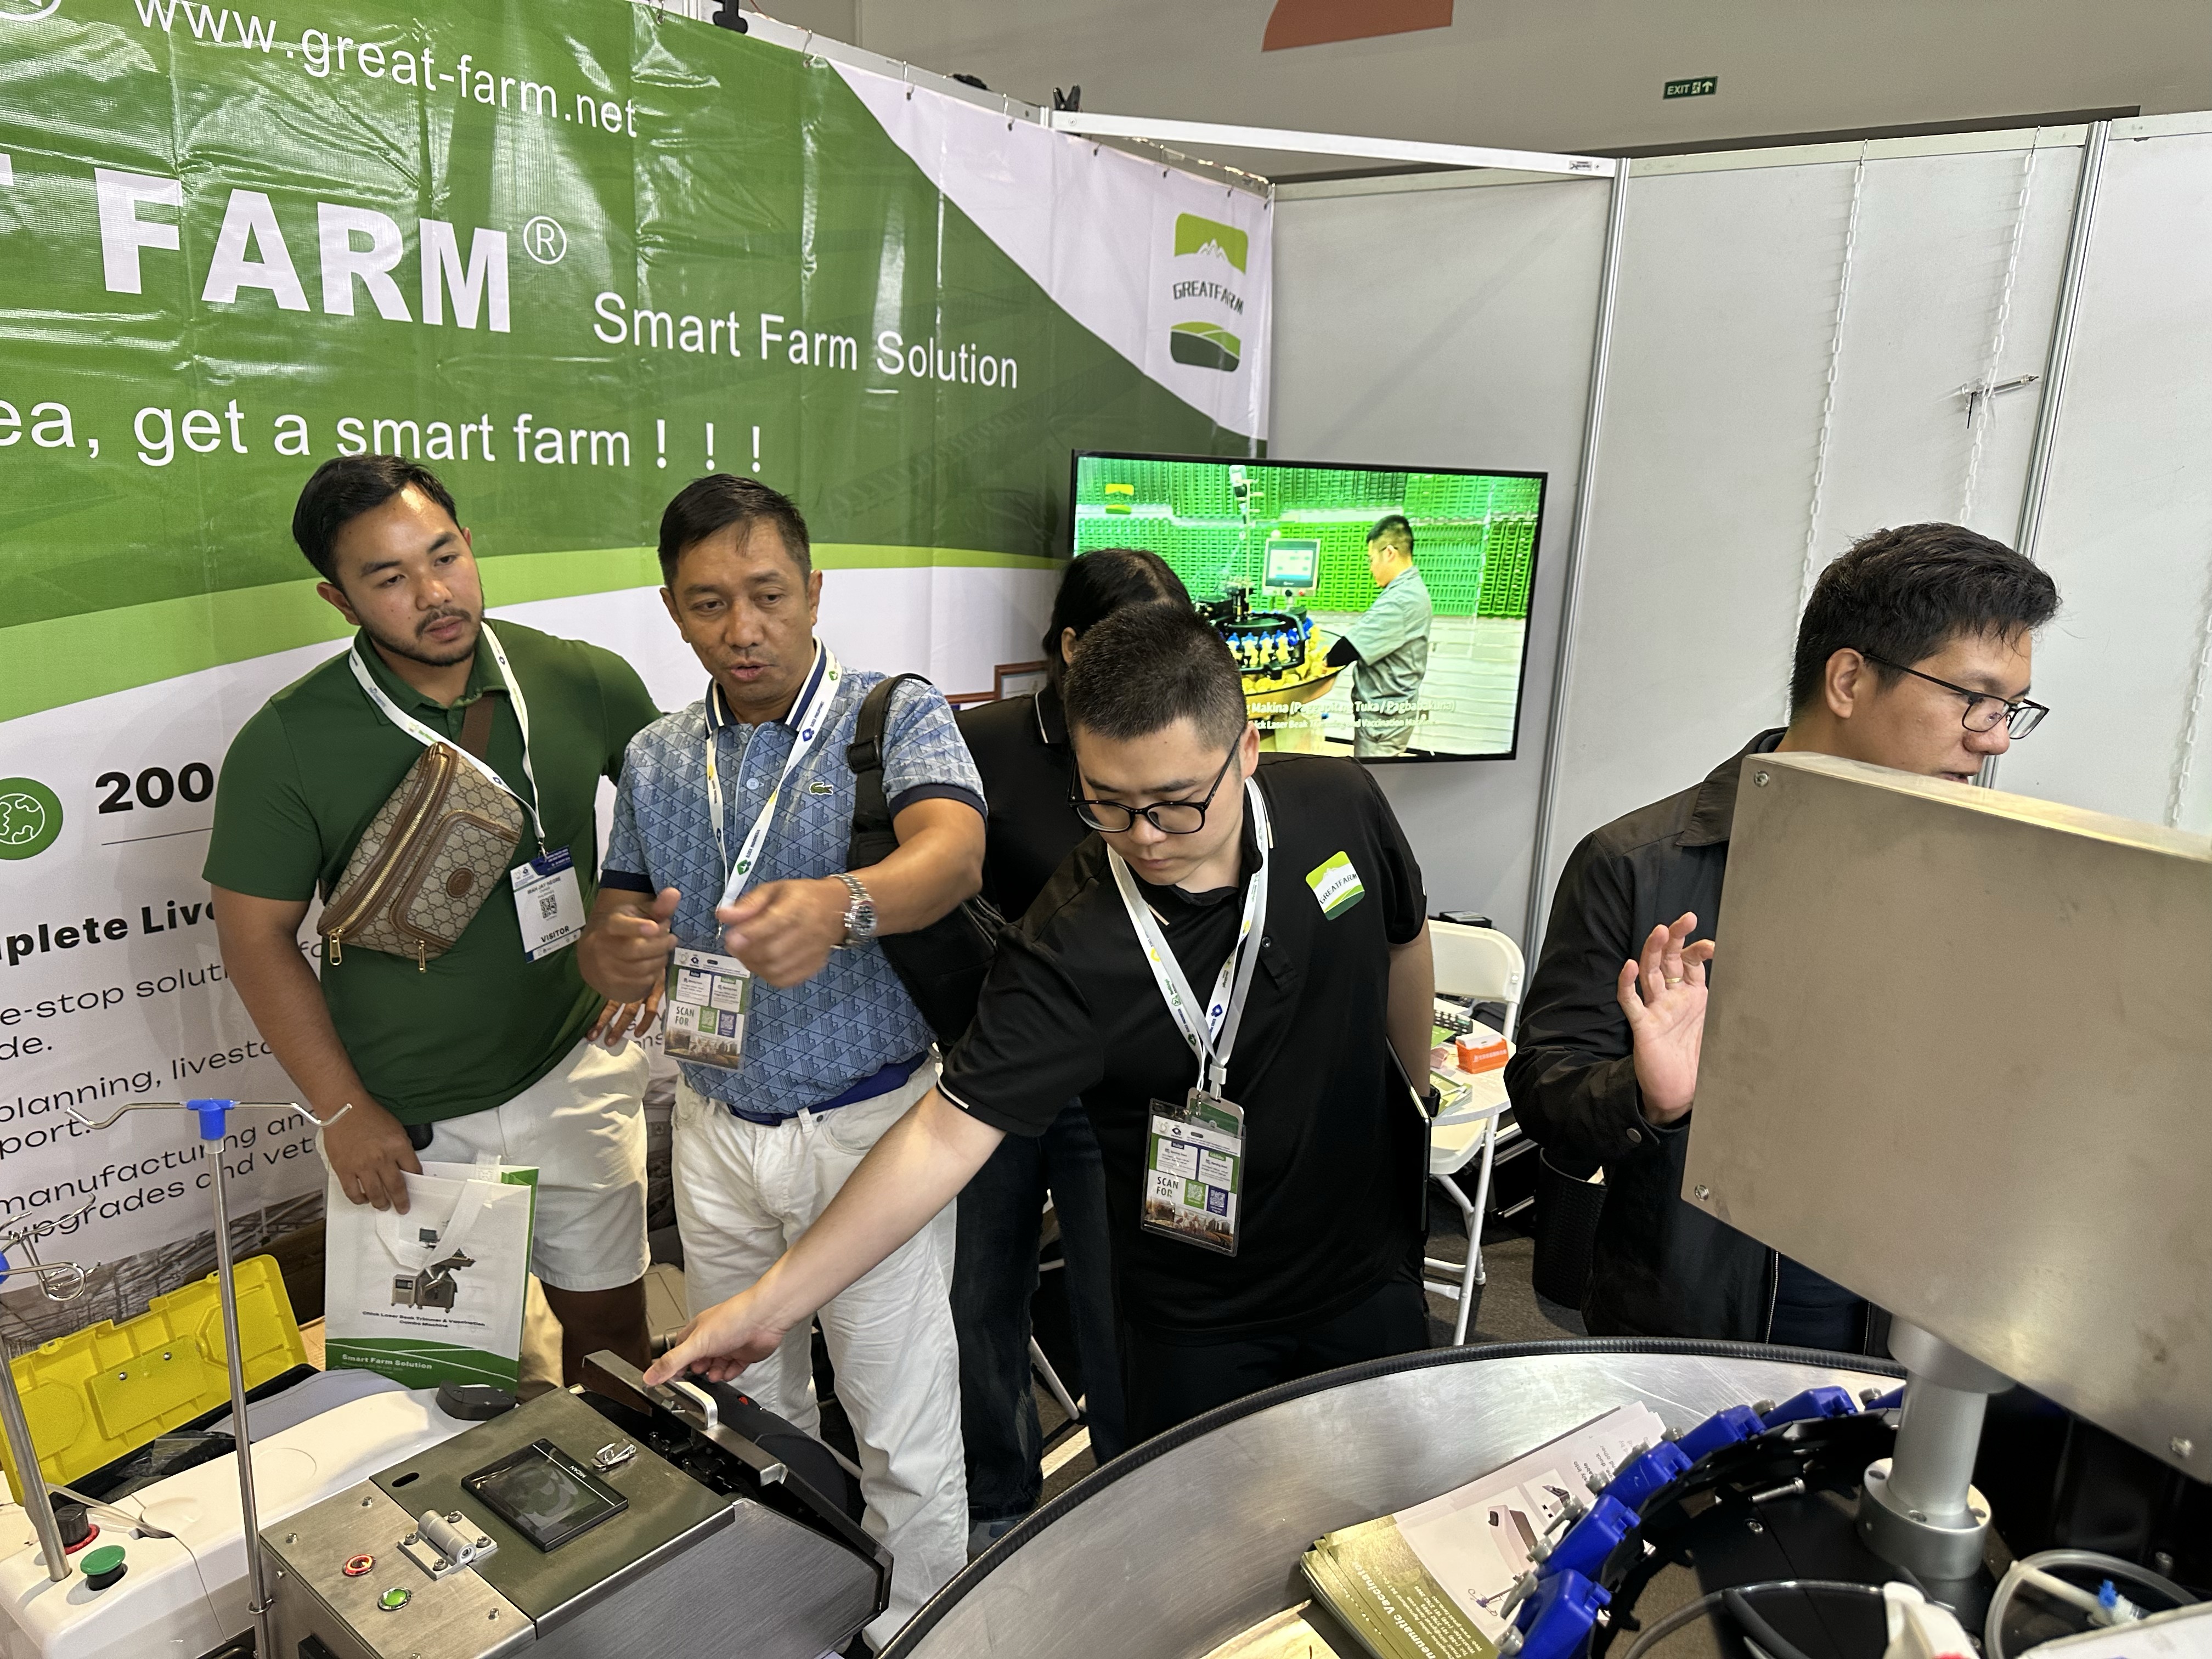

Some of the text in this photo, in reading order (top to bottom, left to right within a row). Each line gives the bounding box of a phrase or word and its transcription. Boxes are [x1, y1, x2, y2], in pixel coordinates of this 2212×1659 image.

[135, 0, 637, 138] www.great-farm.net
[1667, 83, 1690, 95] EXIT
[94, 167, 511, 333] FARM
[1173, 280, 1244, 315] GREATFARM
[594, 291, 1018, 389] Smart Farm Solution
[133, 398, 249, 467] get
[274, 414, 311, 456] a
[336, 413, 495, 461] smart
[513, 413, 630, 467] farm
[1251, 701, 1289, 713] Makina
[1355, 701, 1380, 712] Tuka
[1362, 719, 1404, 727] Vaccination
[95, 762, 214, 814] 200
[1319, 873, 1358, 904] GREATFARM
[0, 917, 129, 967] plete
[540, 925, 570, 943] VISITOR
[0, 987, 124, 1025] e-stop
[675, 1016, 689, 1026] FOR
[676, 1006, 695, 1017] SCAN
[0, 1036, 52, 1060] de.
[0, 1119, 91, 1160] port.
[0, 1109, 315, 1214] manufactung an
[1156, 1186, 1172, 1198] FOR
[1157, 1176, 1178, 1189] SCAN
[8, 1181, 185, 1243] pgrades
[342, 1353, 369, 1364] Smart
[370, 1357, 393, 1365] Farm
[395, 1359, 433, 1370] Solution
[1353, 1561, 1396, 1615] Vaccinator
